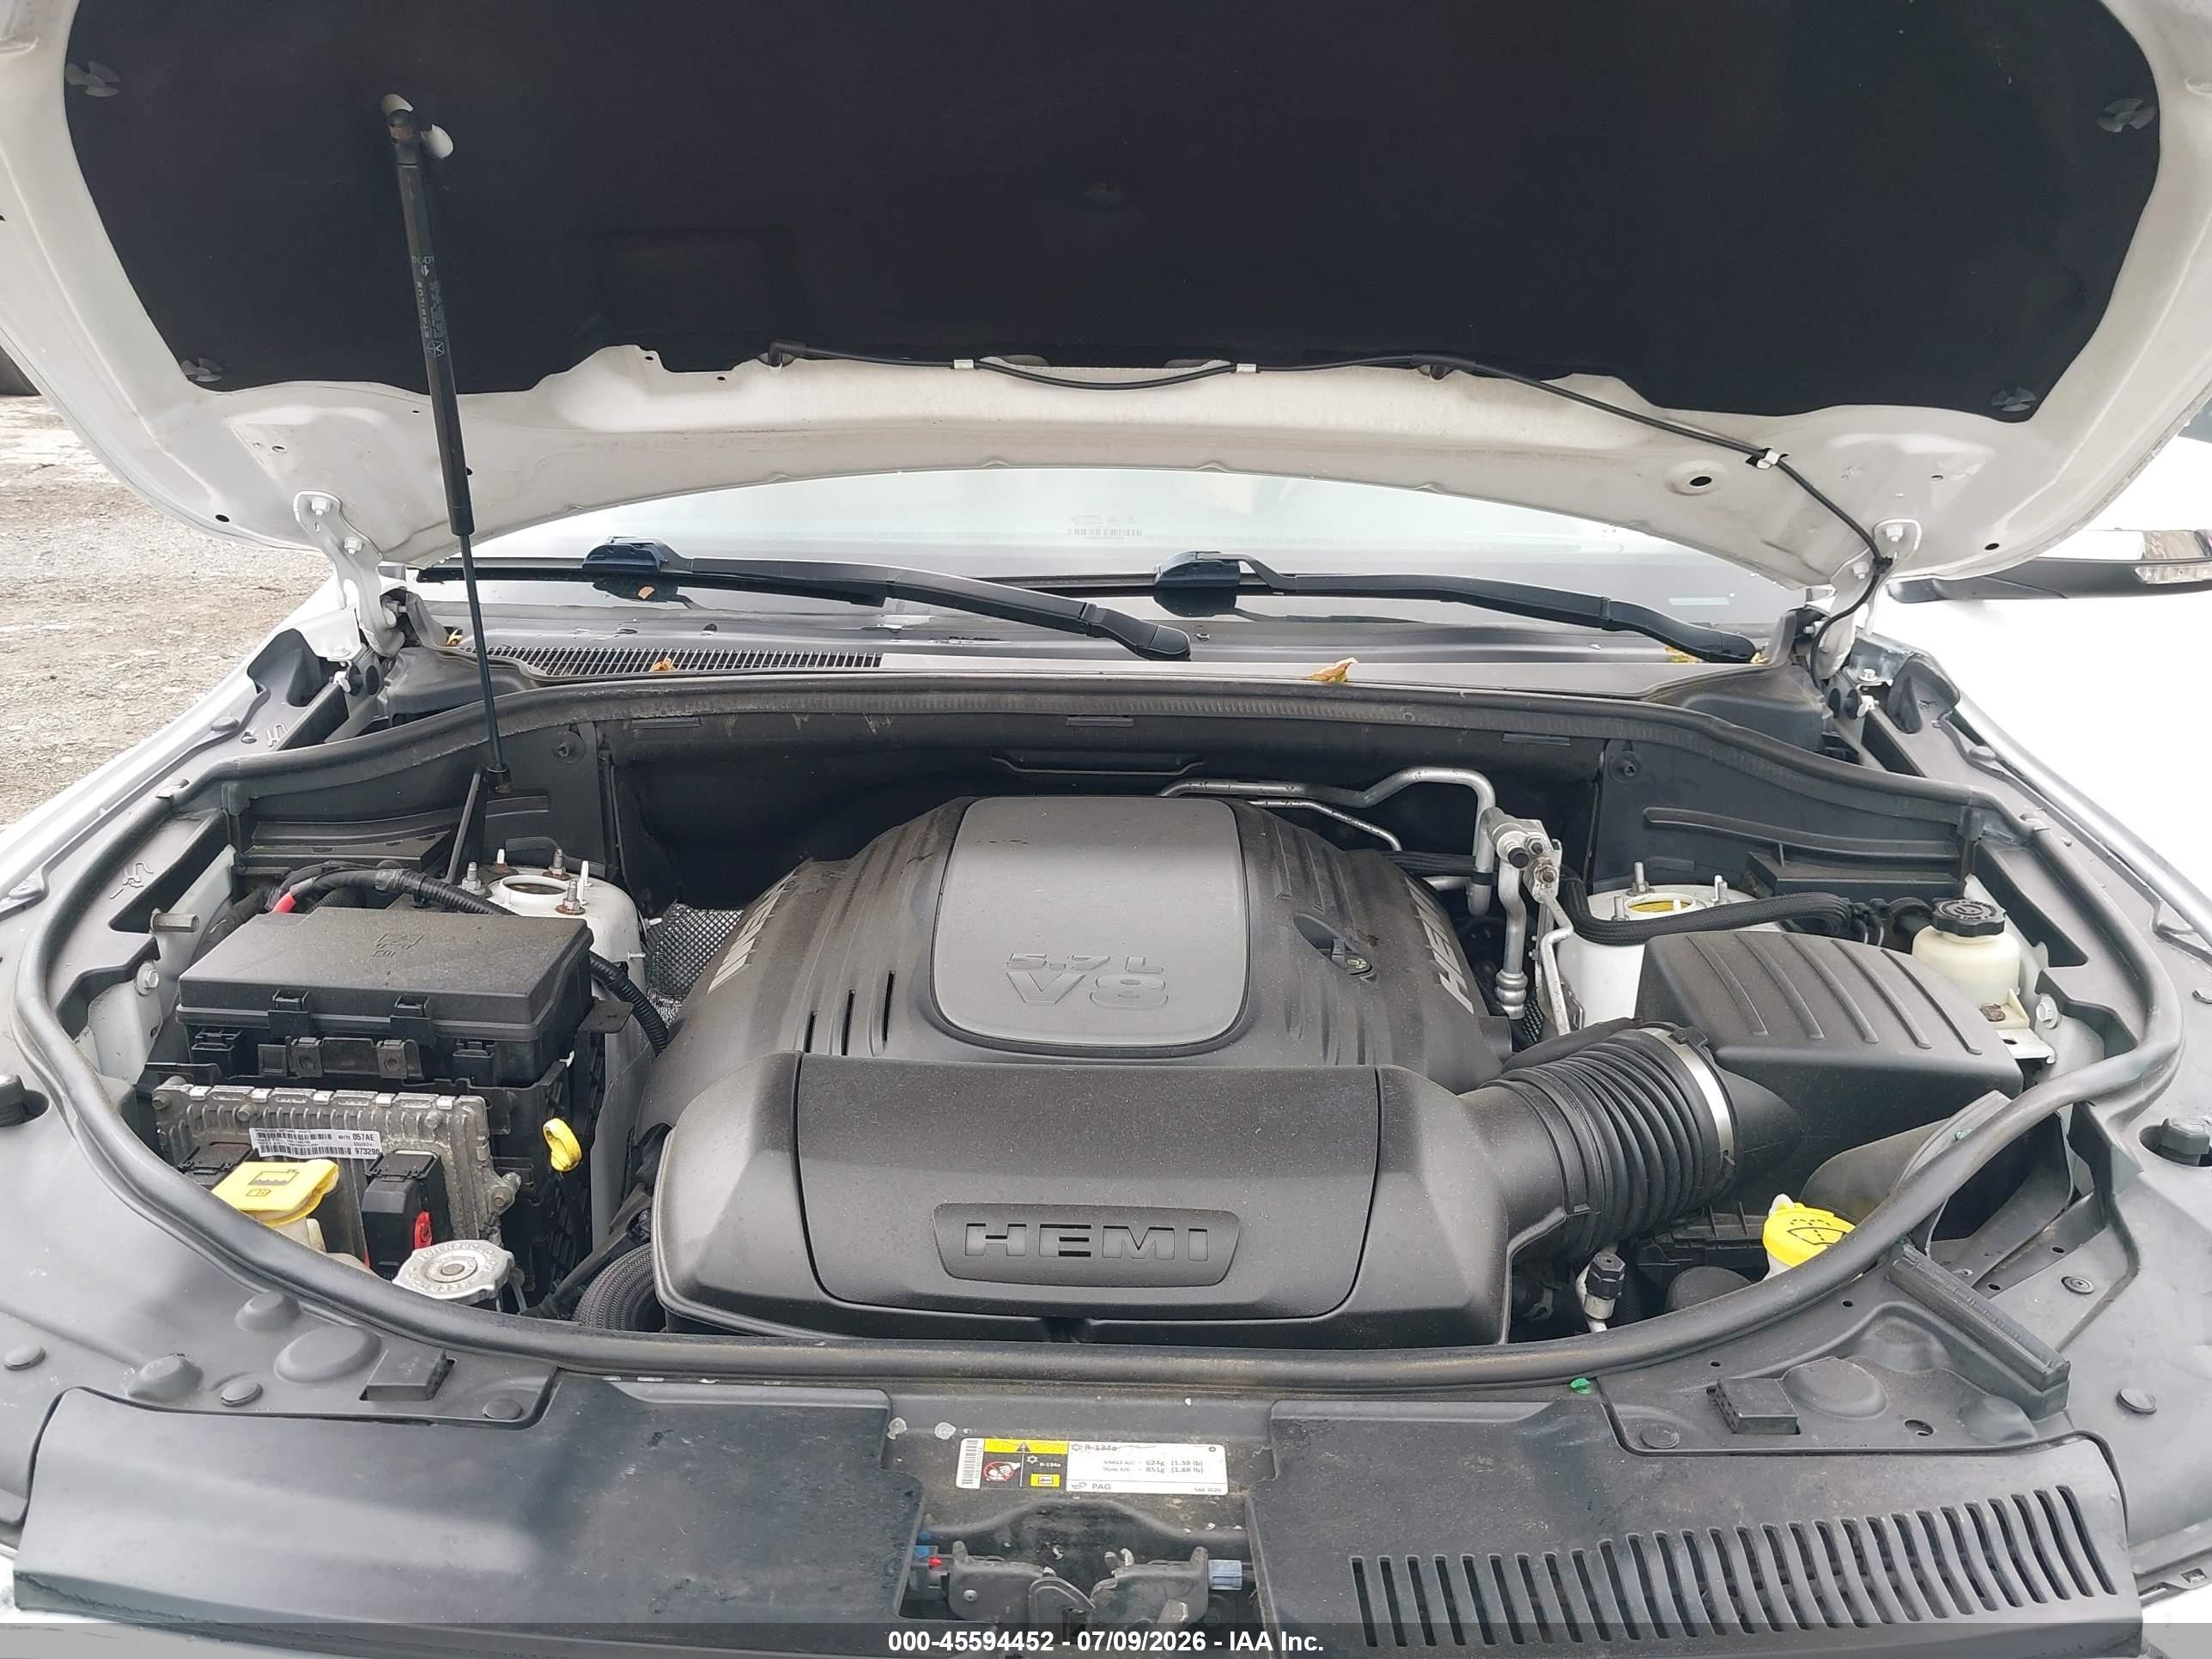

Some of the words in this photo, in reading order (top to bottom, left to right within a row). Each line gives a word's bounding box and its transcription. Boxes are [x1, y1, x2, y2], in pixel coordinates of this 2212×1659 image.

[1006, 971, 1169, 1009] V8
[352, 1133, 375, 1141] 057AE
[964, 1223, 1208, 1261] HEMI
